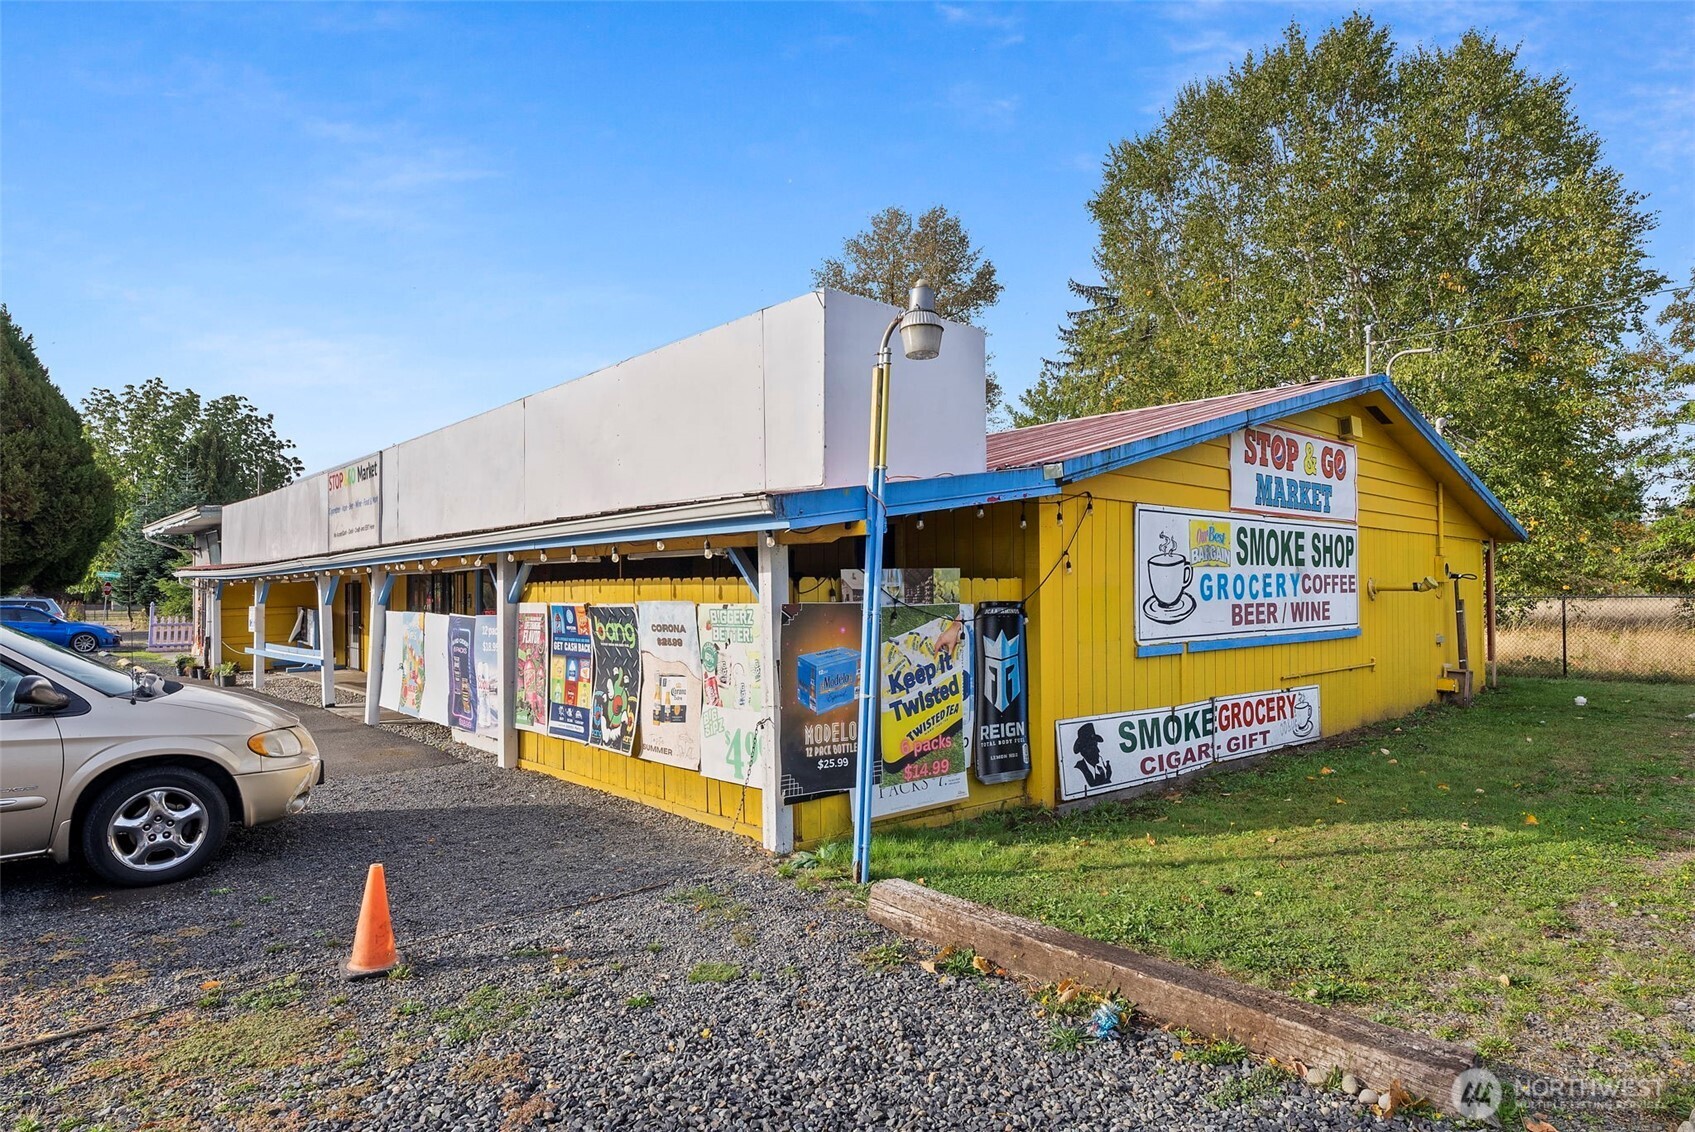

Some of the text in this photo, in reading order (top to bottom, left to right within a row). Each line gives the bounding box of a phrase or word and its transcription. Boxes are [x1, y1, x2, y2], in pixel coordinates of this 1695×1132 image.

[1244, 428, 1347, 480] STOP & GO
[329, 472, 344, 491] STOP
[357, 461, 378, 482] Market
[1255, 473, 1332, 513] MARKET
[1197, 526, 1225, 544] Our Best
[1191, 545, 1231, 565] BARGAIN
[1236, 526, 1354, 568] SMOKE SHOP
[1200, 573, 1356, 601] GROCERY COFFEE
[1231, 601, 1330, 626] BEER / WINE
[488, 627, 497, 638] pac
[594, 615, 635, 648] bang
[651, 624, 686, 634] CORONA
[553, 641, 563, 651] GET
[564, 642, 577, 652] CASH
[578, 643, 591, 653] BACK
[823, 673, 850, 688] Modelo
[888, 653, 954, 695] Keep It
[671, 687, 687, 696] Corona
[889, 674, 959, 721] Twisted
[804, 721, 857, 745] MODELO
[906, 710, 945, 742] TWISTED
[945, 703, 960, 717] TEA
[981, 721, 1025, 740] REIGN
[1118, 708, 1217, 753] SMOKE
[1218, 693, 1296, 732] GROCERY
[642, 743, 673, 757] SUMMER
[806, 742, 858, 757] 12 PACK BOTTLE
[901, 738, 910, 755] 6
[914, 734, 952, 757] packs
[1140, 742, 1211, 776] CIGAR
[1226, 730, 1271, 753] GIFT
[817, 757, 849, 770] $25.99
[904, 759, 950, 781] $14.99
